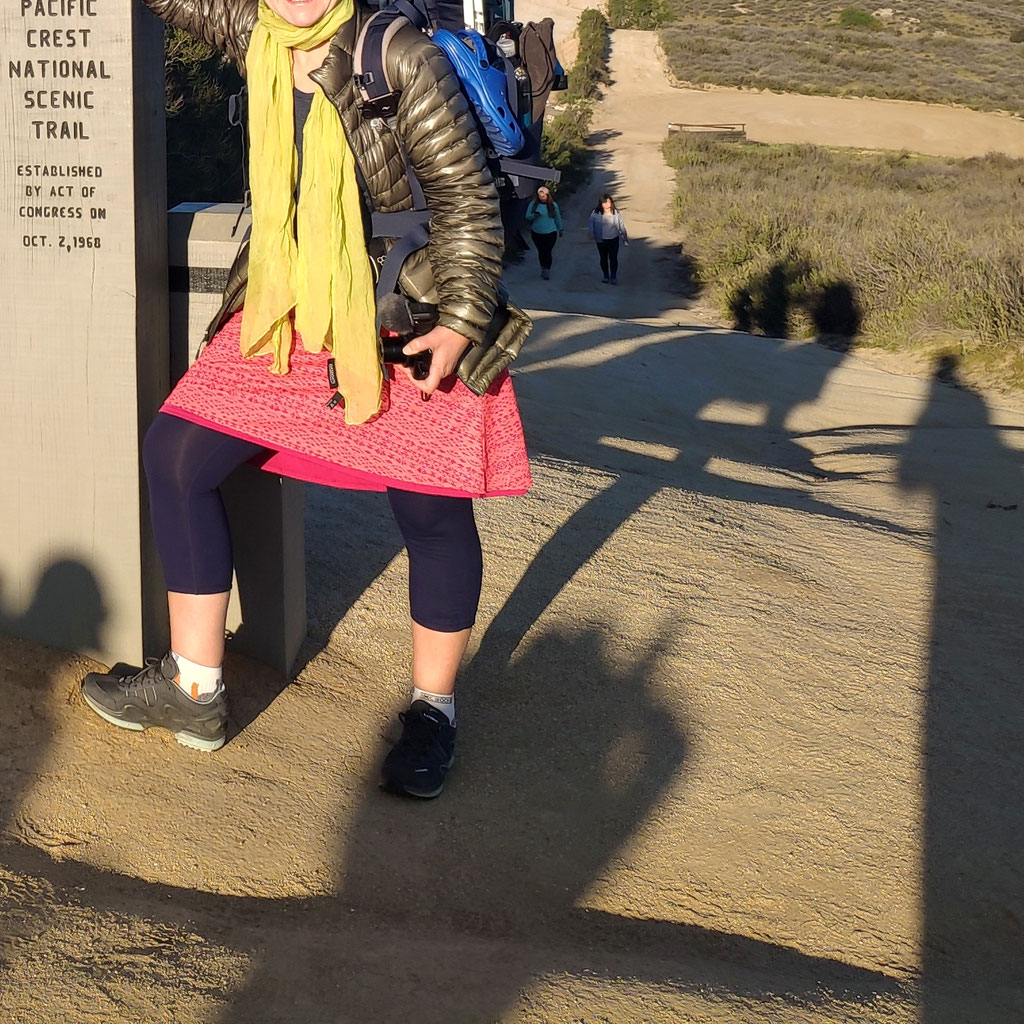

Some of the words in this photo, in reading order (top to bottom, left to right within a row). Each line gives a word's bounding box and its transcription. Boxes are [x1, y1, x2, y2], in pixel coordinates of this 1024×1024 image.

[26, 28, 91, 48] CREST
[9, 59, 111, 79] NATIONAL
[24, 90, 95, 110] SCENIC
[32, 120, 89, 140] TRAIL
[17, 164, 103, 178] ESTABLISHED
[25, 185, 42, 197] BY
[49, 185, 74, 197] ACT
[81, 185, 96, 198] OF
[19, 206, 83, 218] CONGRESS
[90, 207, 107, 220] ON
[22, 235, 52, 248] OCT.
